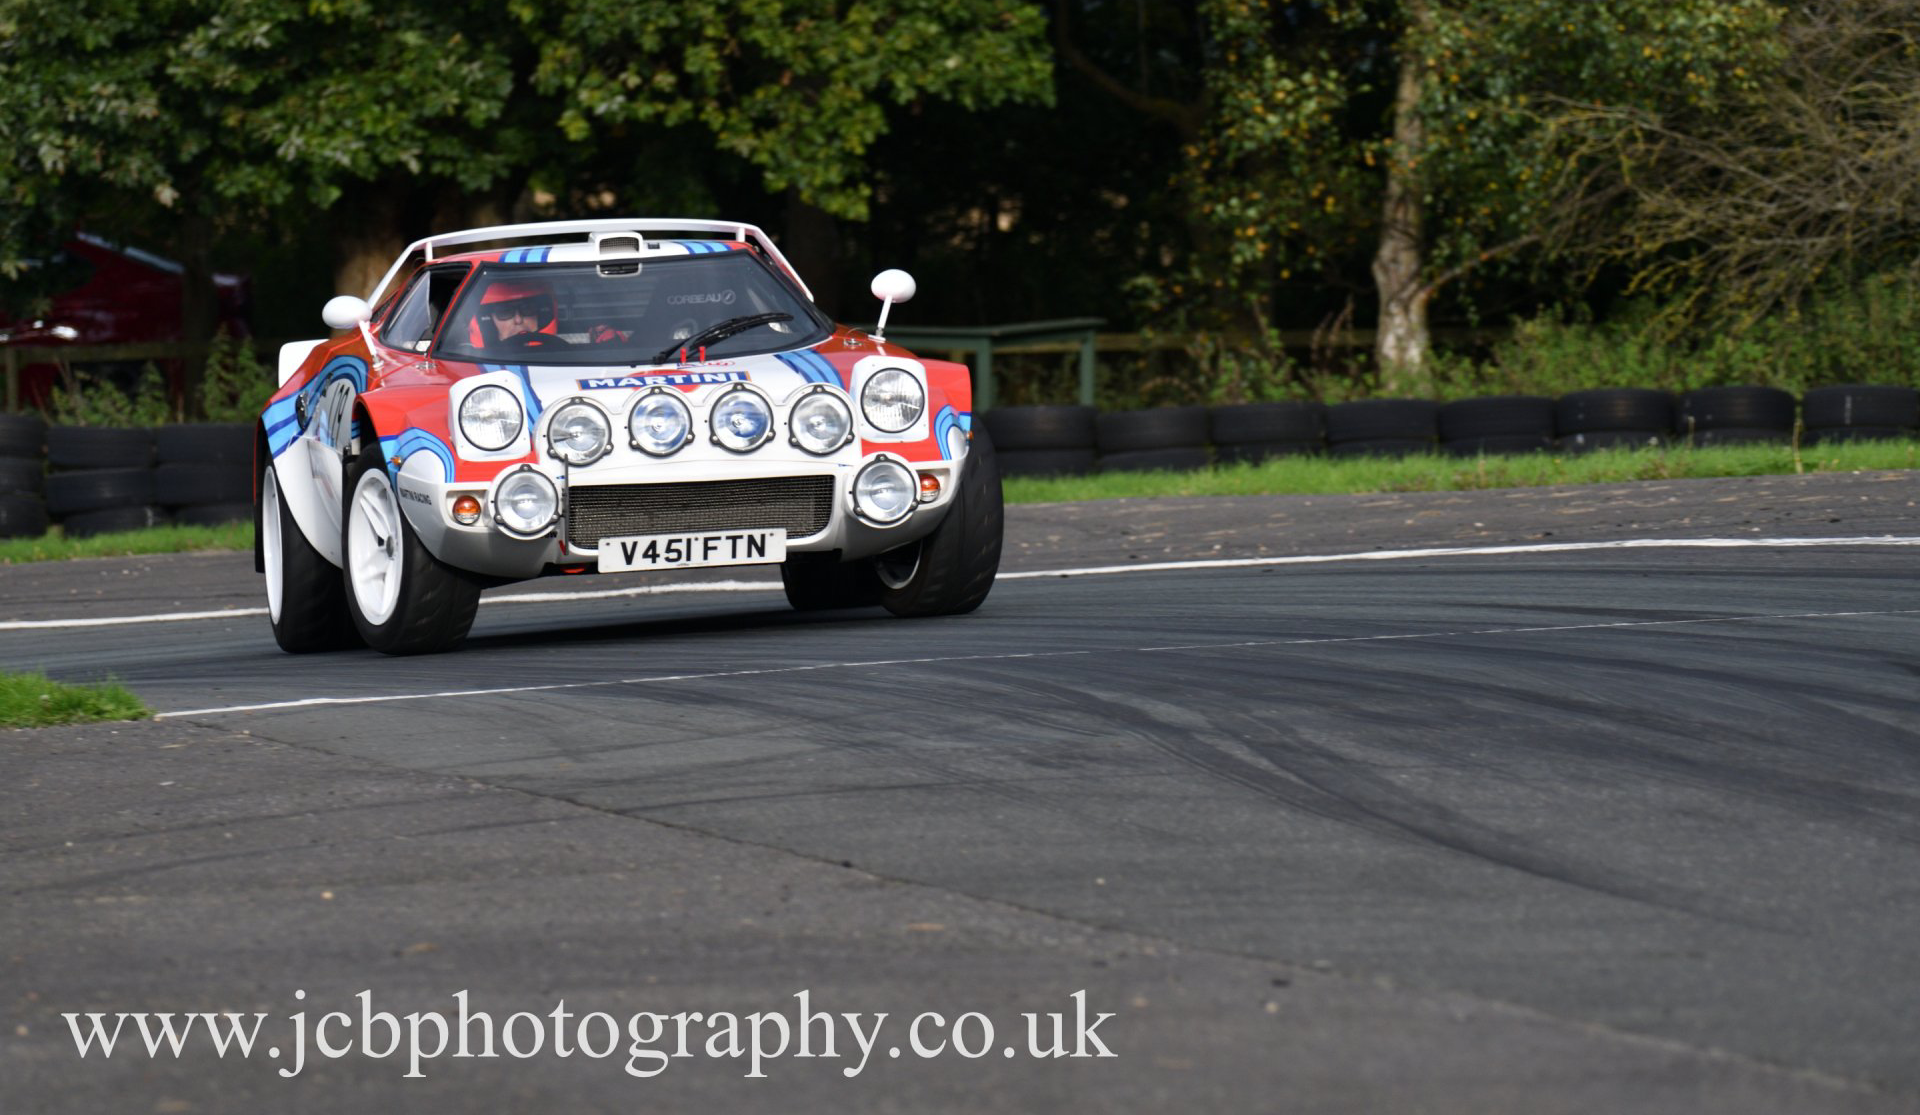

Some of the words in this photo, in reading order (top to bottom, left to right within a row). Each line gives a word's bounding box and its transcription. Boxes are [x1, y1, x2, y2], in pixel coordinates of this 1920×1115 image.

[666, 293, 721, 305] CORBEAU
[588, 372, 743, 388] MARTINI
[620, 538, 691, 565] V451
[703, 534, 766, 561] FTN
